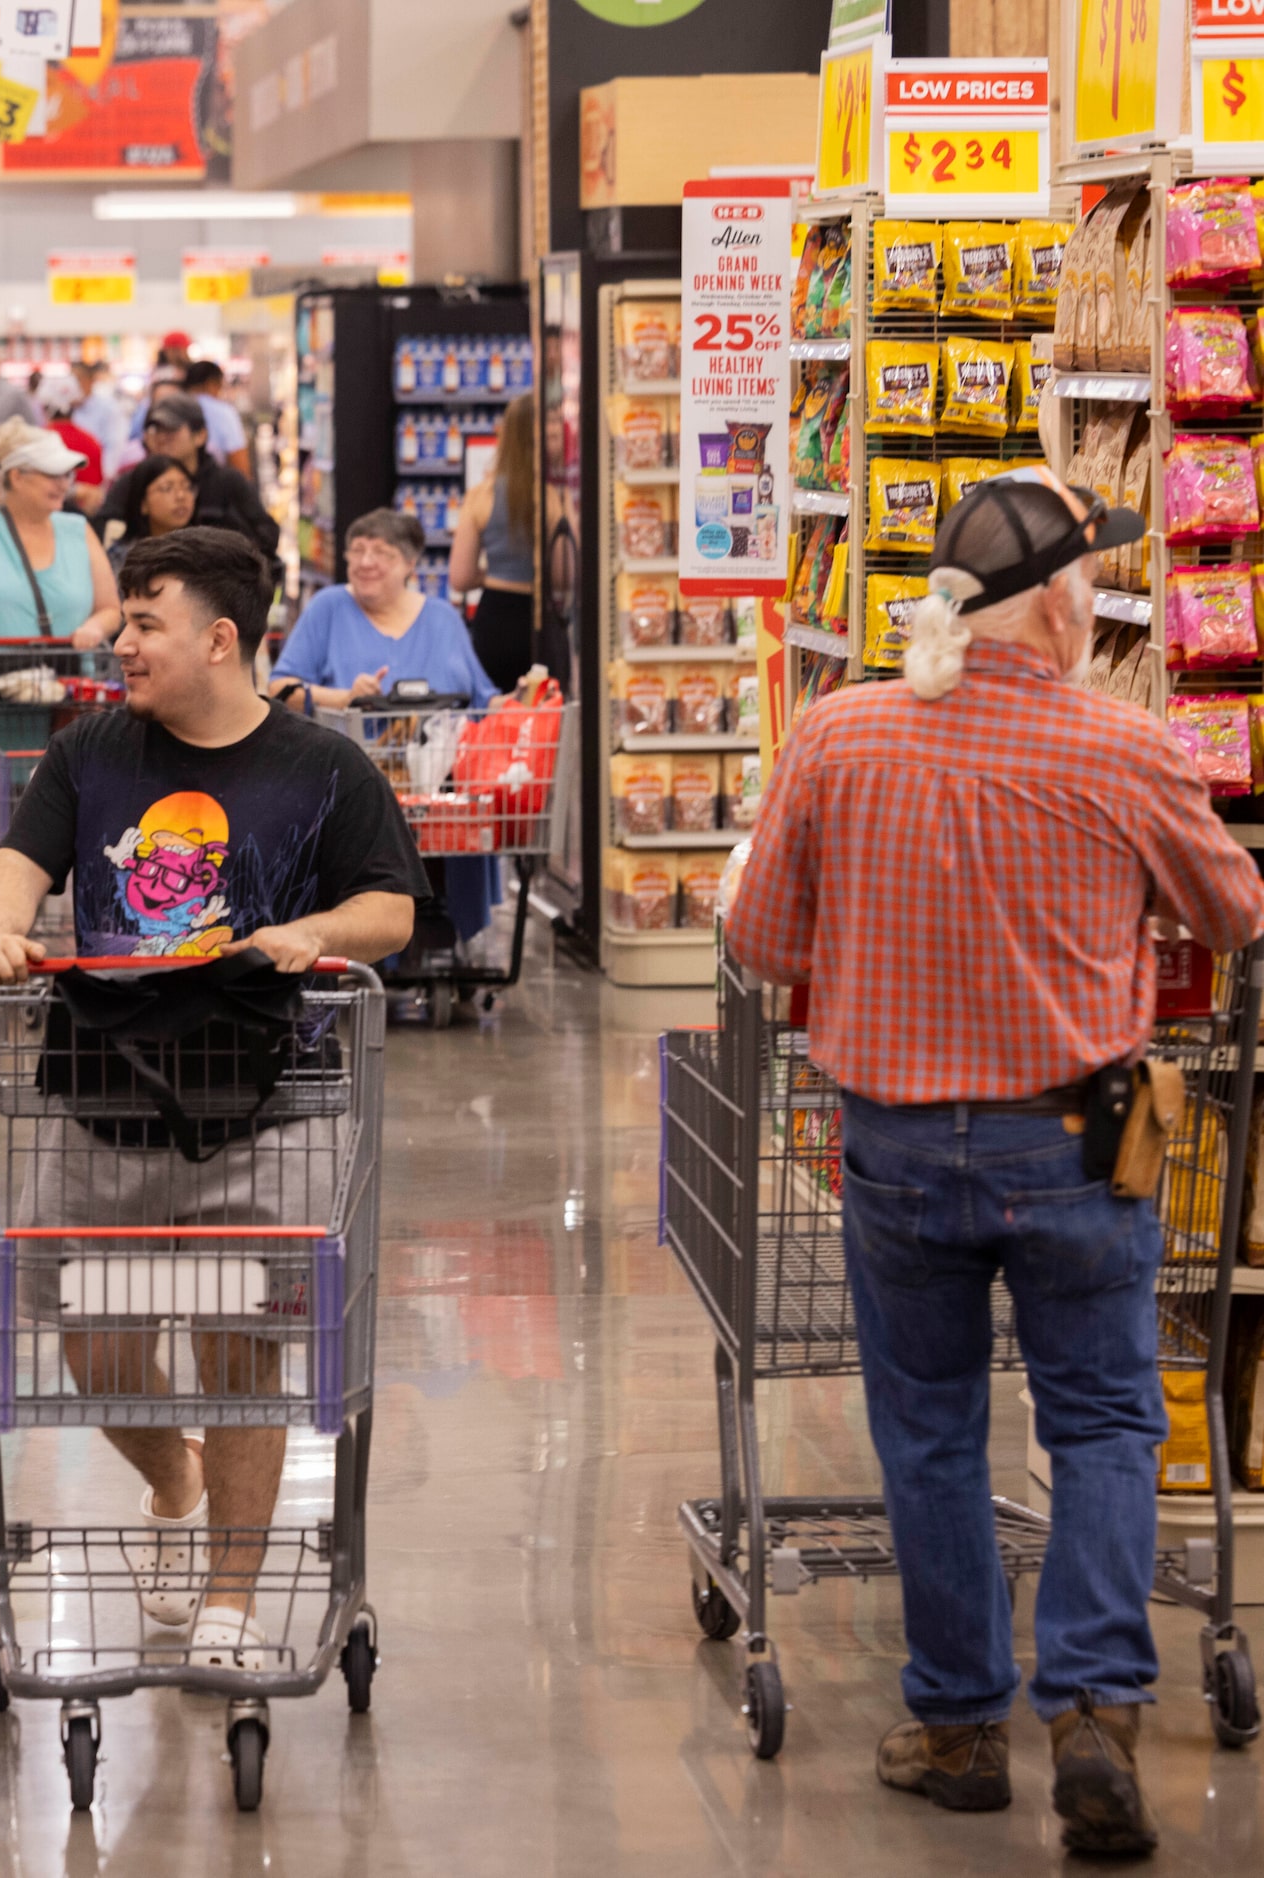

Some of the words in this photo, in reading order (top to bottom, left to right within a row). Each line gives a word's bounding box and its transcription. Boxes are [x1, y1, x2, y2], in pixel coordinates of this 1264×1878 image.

[899, 80, 952, 100] LOW
[955, 79, 1035, 100] PRICES
[1222, 60, 1247, 117] $
[717, 205, 759, 219] H-E-B
[711, 225, 762, 249] Allen
[718, 255, 758, 272] GRAND
[693, 274, 746, 291] OPENING
[750, 274, 782, 291] WEEK
[692, 313, 781, 351] 25%
[754, 340, 782, 351] OFF
[709, 356, 764, 374] HEALTHY
[692, 378, 733, 396] LIVING
[888, 483, 930, 501] HERSHEY'S
